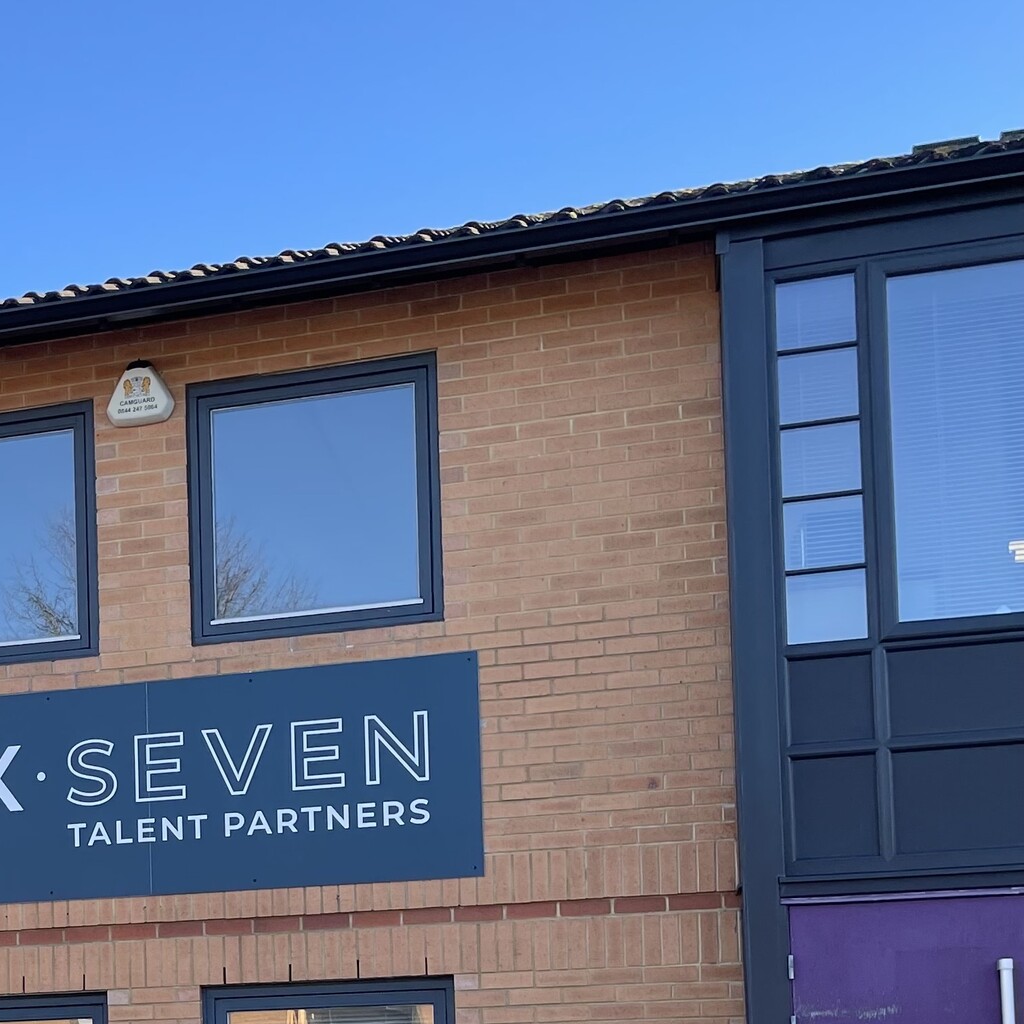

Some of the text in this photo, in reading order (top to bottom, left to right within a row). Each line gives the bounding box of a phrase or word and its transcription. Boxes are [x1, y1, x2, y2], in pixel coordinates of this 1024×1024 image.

[119, 397, 156, 406] CAMGUARD
[66, 710, 430, 807] SEVEN
[66, 798, 432, 848] TALENT PARTNERS
